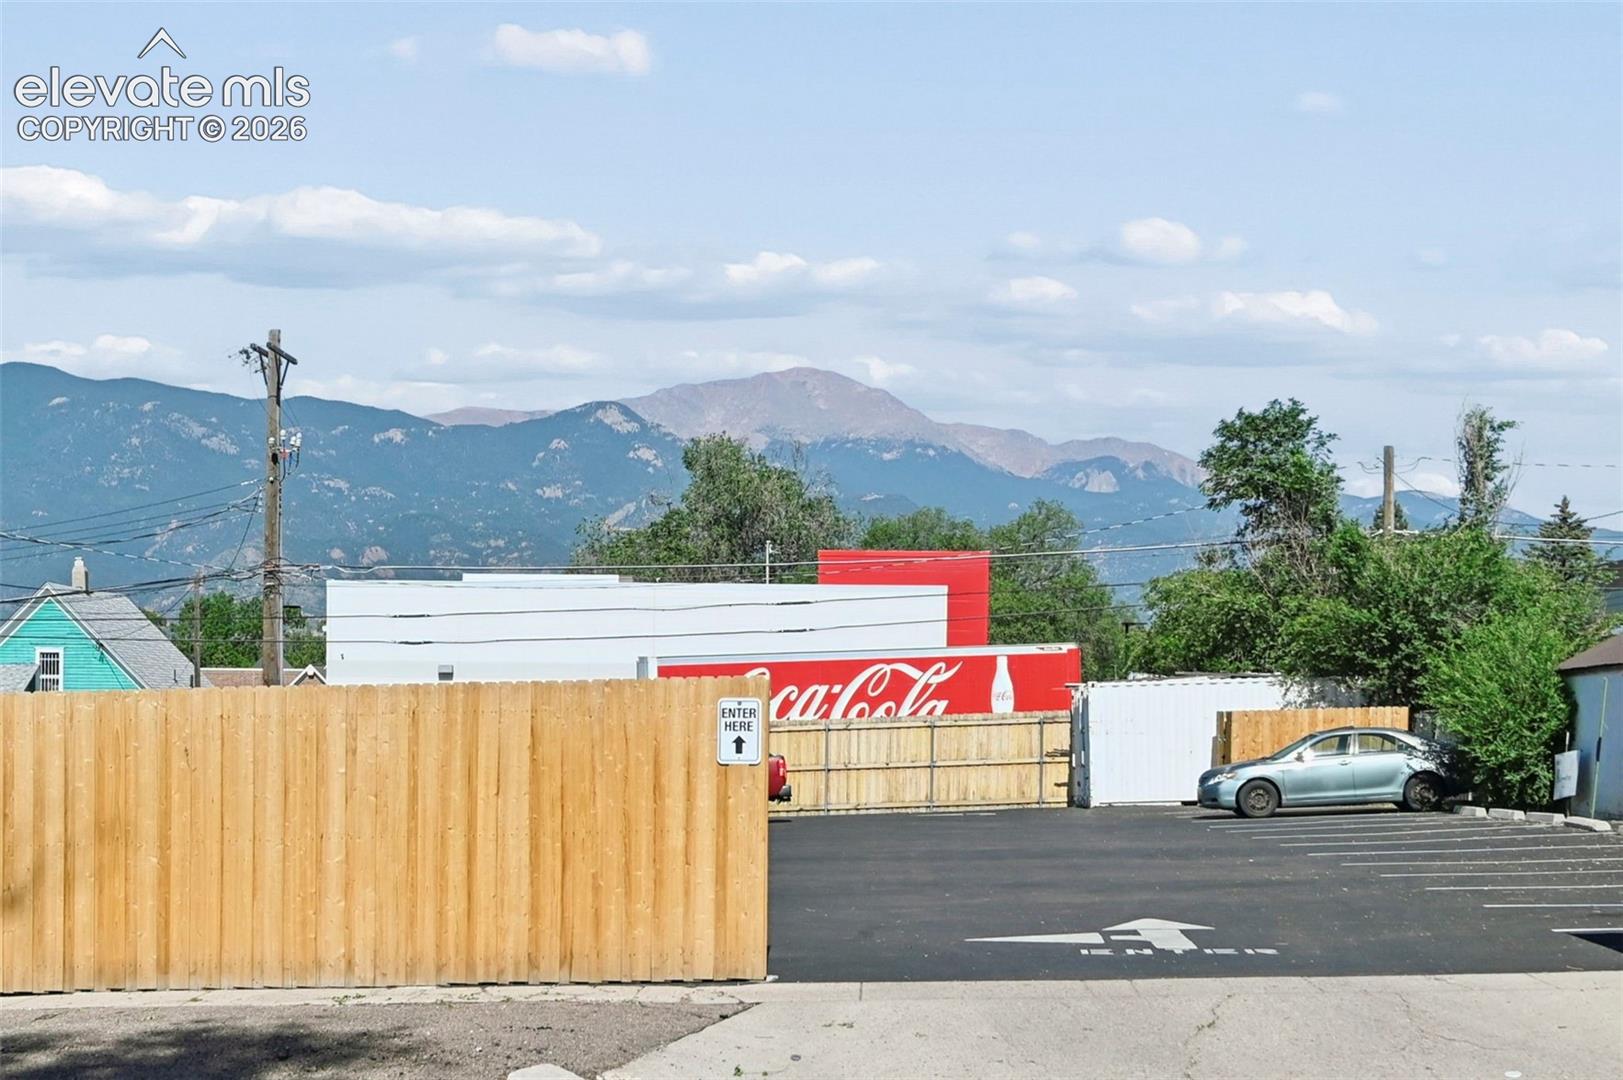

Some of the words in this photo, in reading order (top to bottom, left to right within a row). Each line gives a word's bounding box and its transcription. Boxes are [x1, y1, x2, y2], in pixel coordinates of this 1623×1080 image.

[744, 660, 963, 721] ca-Cola
[721, 707, 757, 719] ENTER
[724, 720, 754, 732] HERE
